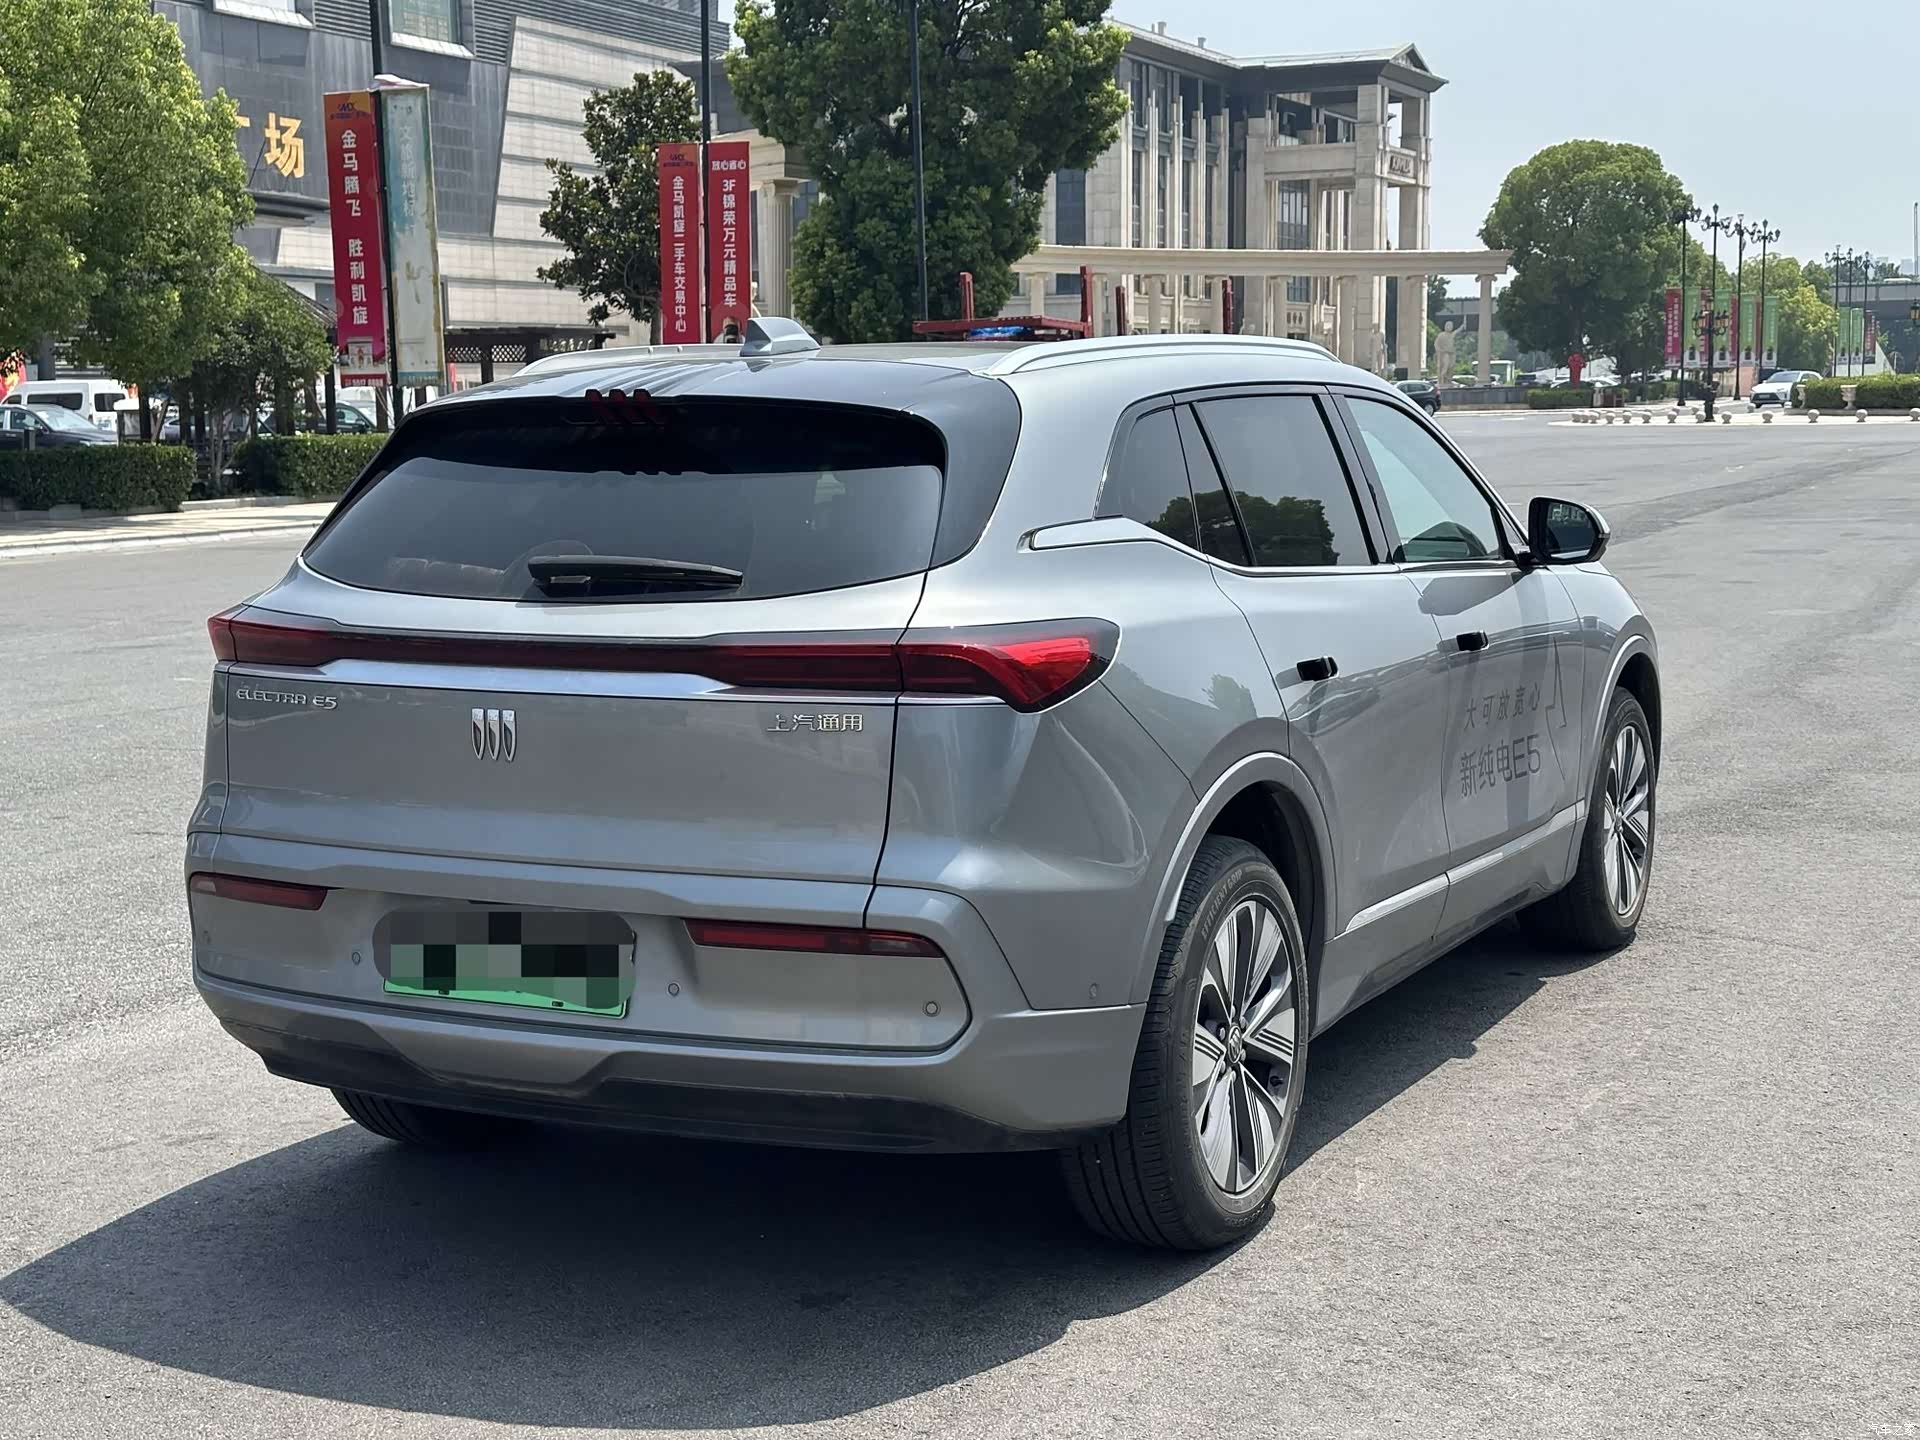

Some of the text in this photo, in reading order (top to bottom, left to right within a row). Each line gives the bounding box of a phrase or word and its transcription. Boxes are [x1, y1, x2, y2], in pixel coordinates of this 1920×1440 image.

[341, 129, 361, 217] 金马腾飞
[348, 238, 368, 325] 胜利凯旋
[672, 175, 687, 333] 金马凯旋二手车交易中心
[236, 688, 337, 710] ELECTRA E5
[766, 713, 863, 732] 上汽通用
[1463, 682, 1541, 730] 大可放宽心
[1460, 734, 1542, 797] 新纯电E5
